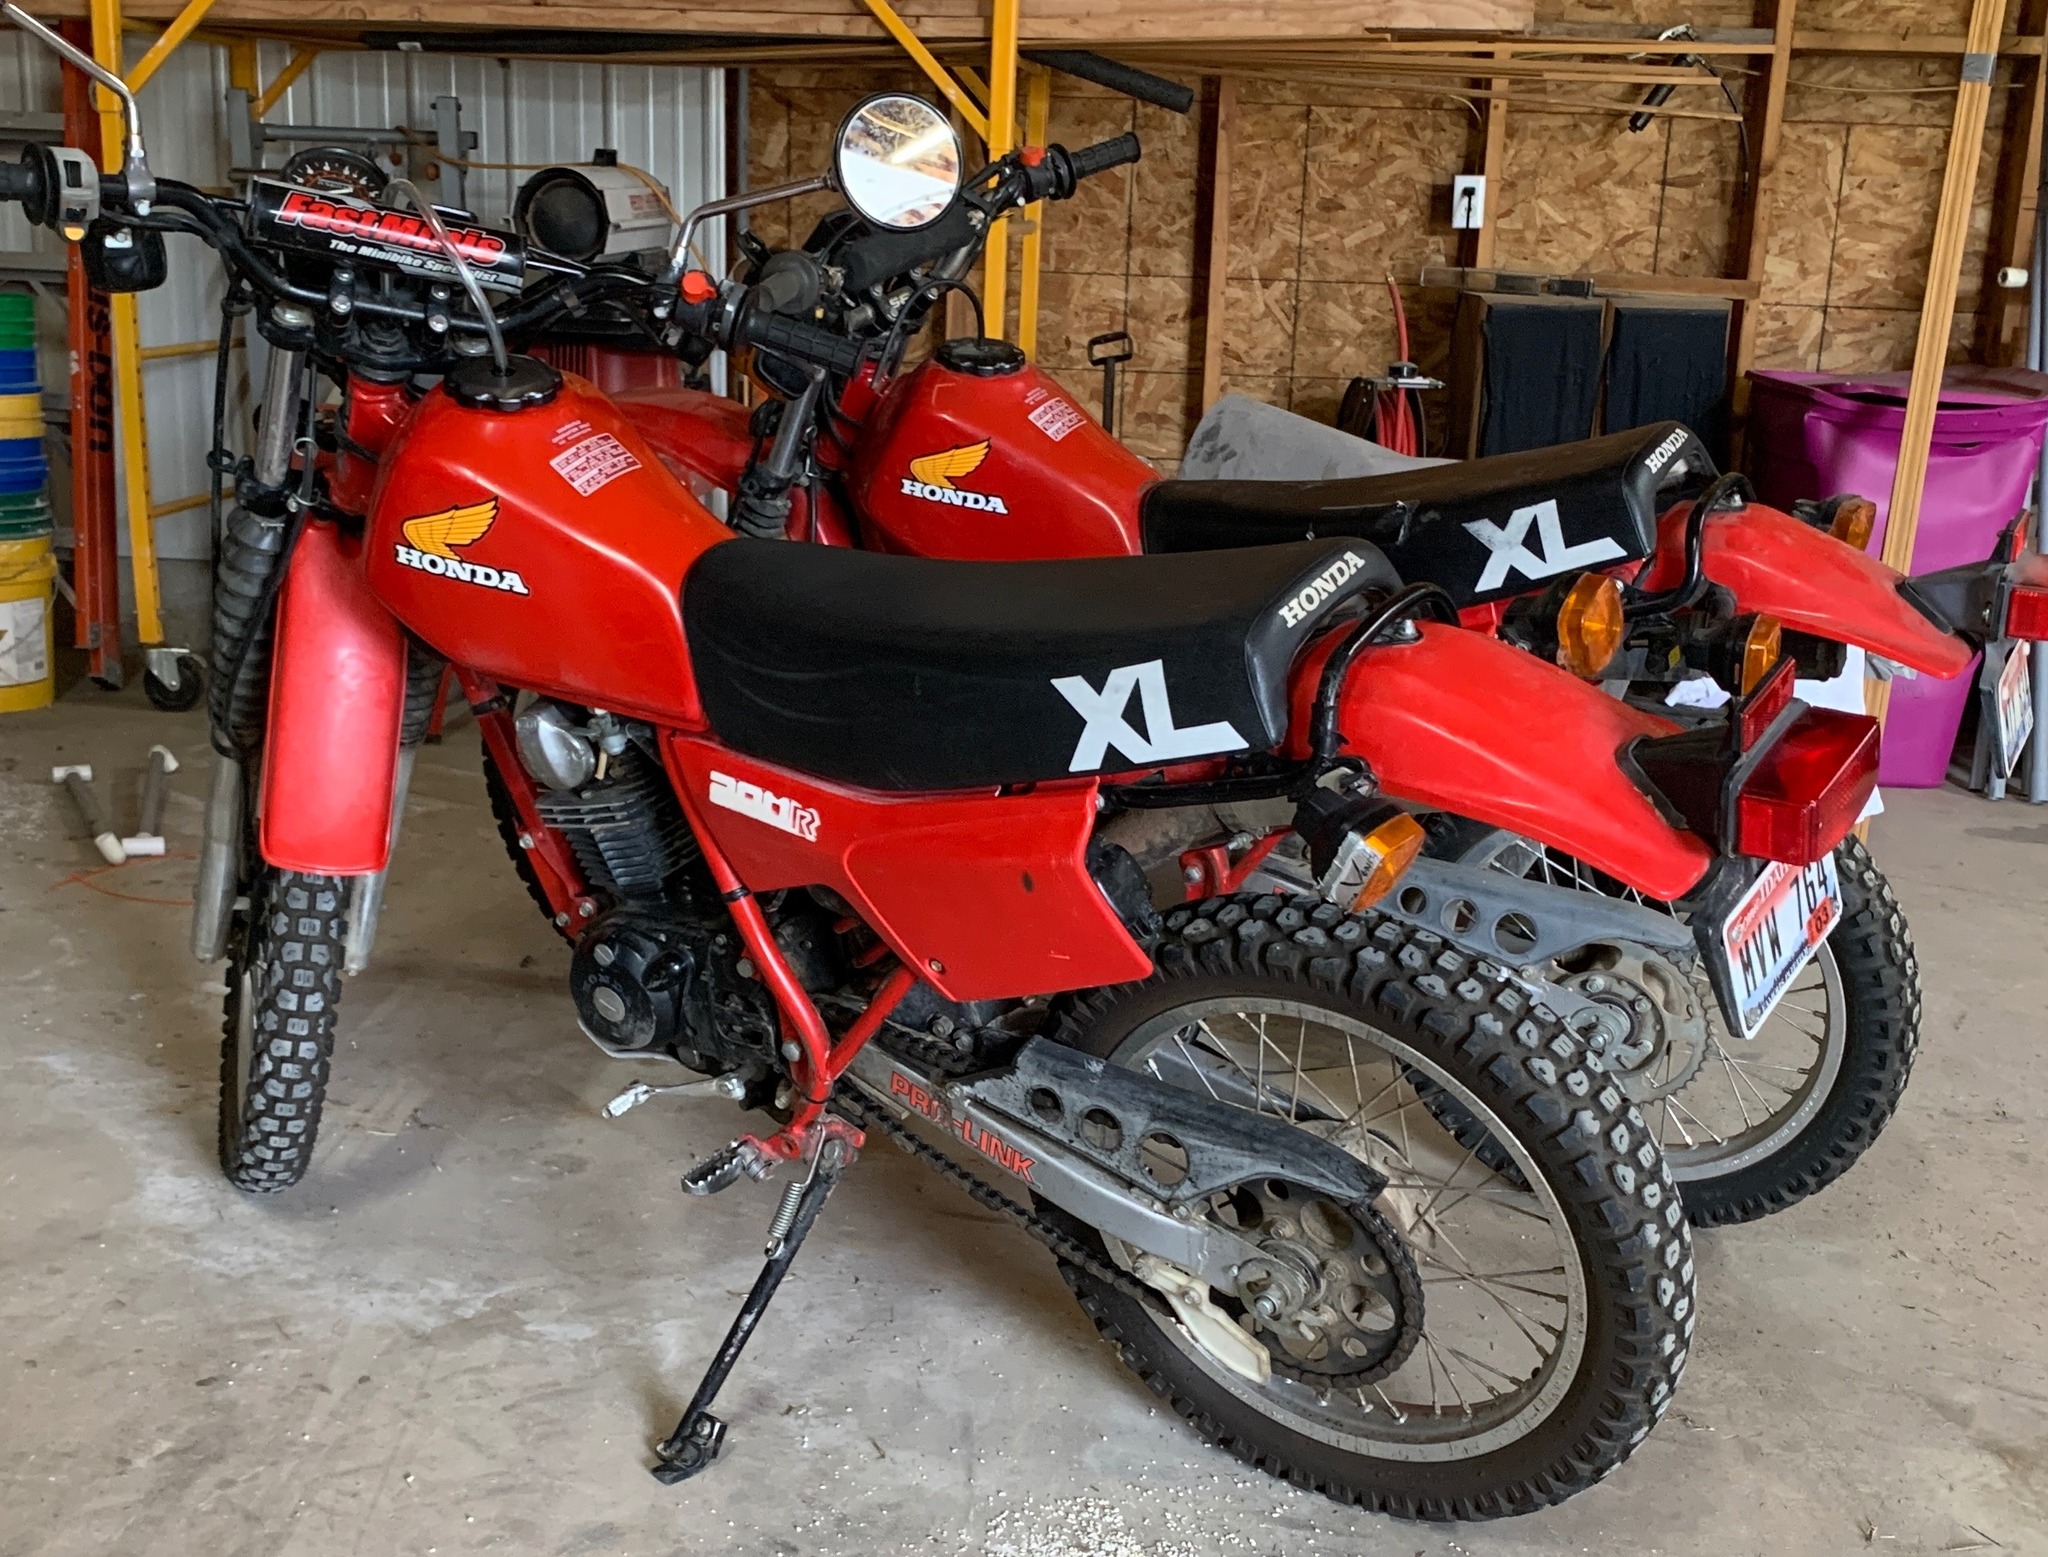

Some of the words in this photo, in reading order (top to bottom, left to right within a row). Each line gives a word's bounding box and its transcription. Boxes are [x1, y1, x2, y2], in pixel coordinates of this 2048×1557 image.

[277, 192, 504, 265] FastMinis
[329, 239, 358, 253] The
[357, 245, 423, 267] Minibike
[423, 259, 499, 282] Speclist
[1644, 427, 1689, 474] HONDA
[901, 478, 1009, 515] HONDA
[395, 544, 529, 595] HONDA
[1461, 498, 1628, 594] XL
[1278, 550, 1366, 629] HONDA
[1050, 658, 1250, 773] XL
[1739, 906, 1782, 998] MVW
[1790, 860, 1829, 931] 764
